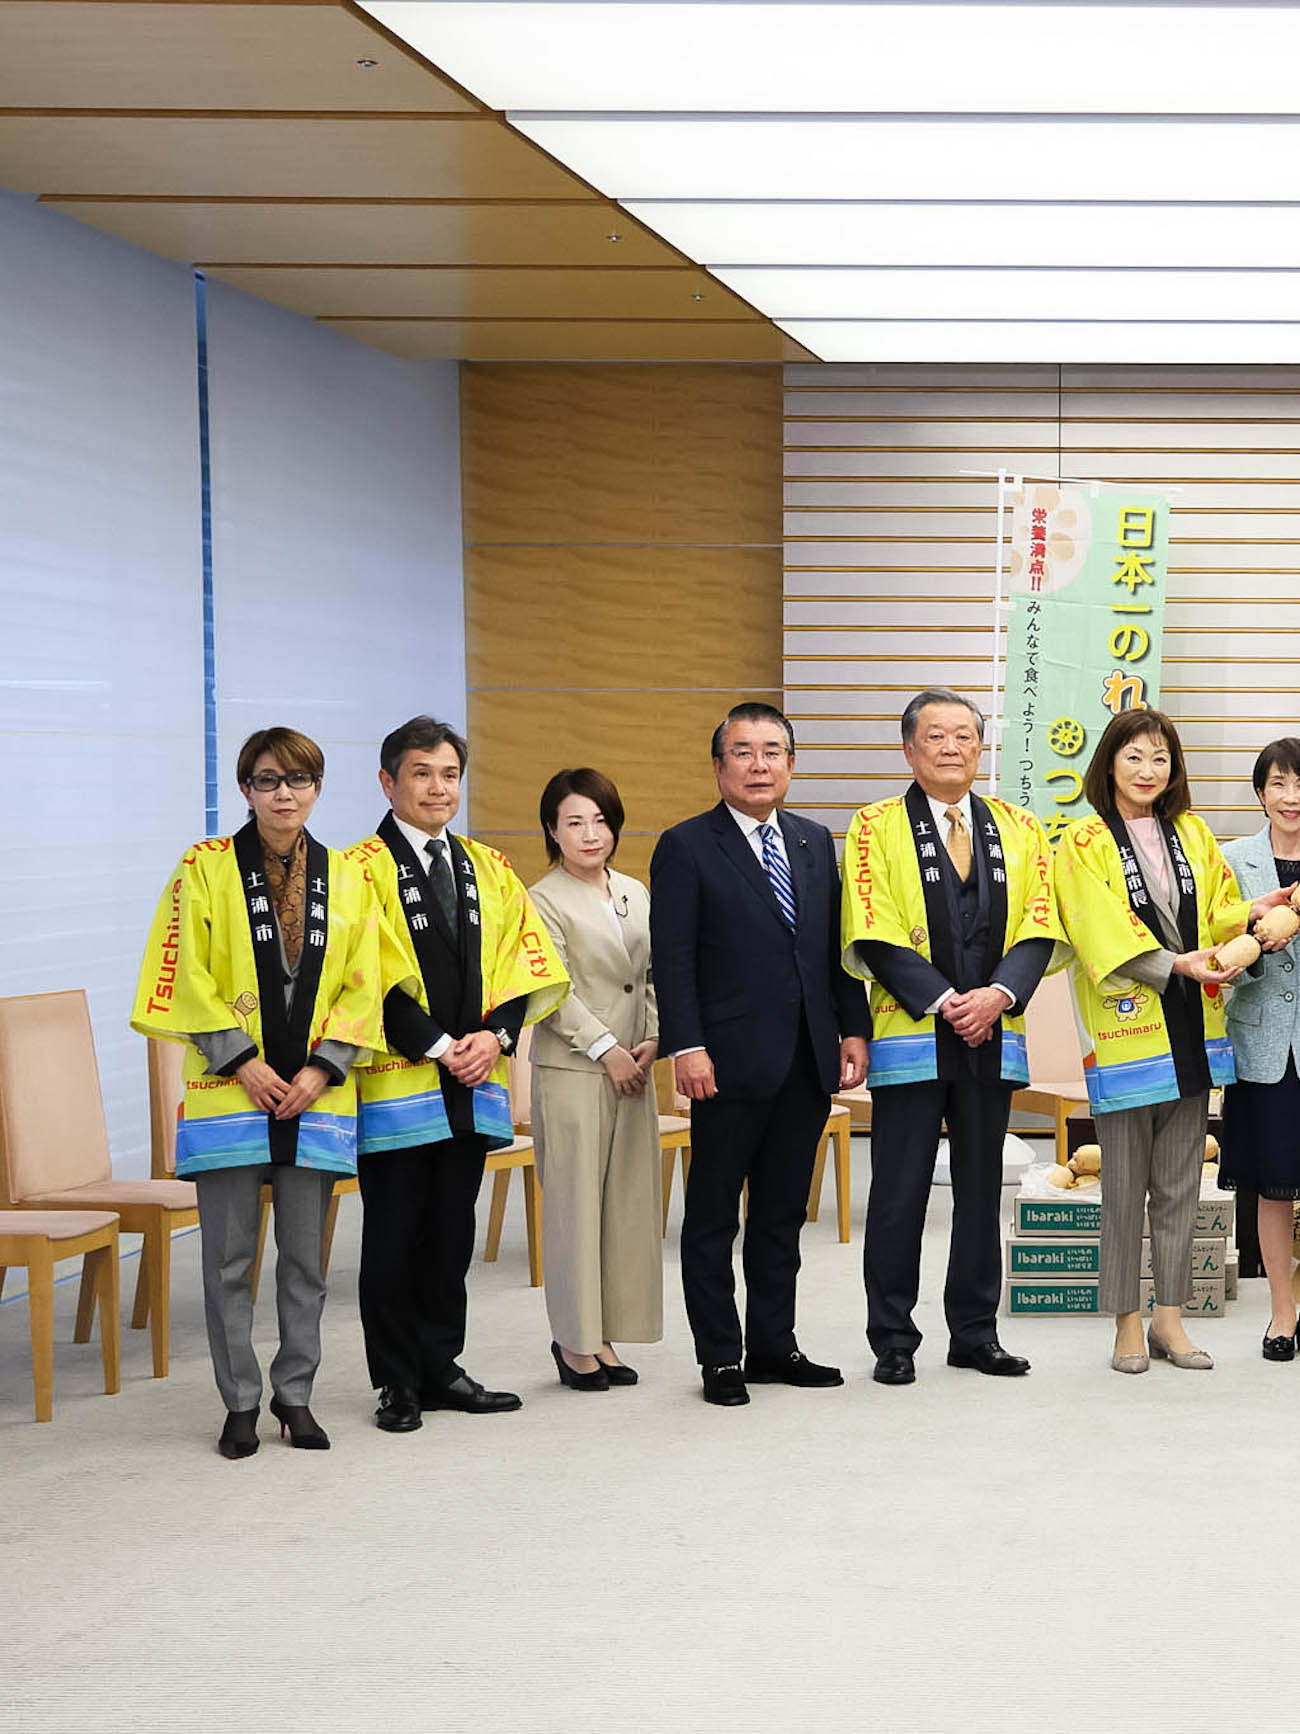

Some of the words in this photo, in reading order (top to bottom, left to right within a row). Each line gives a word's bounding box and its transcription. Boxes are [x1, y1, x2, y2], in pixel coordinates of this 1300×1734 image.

[916, 820, 941, 883] 土浦市
[985, 822, 1005, 883] 土浦市
[248, 872, 273, 942] 土浦市
[310, 877, 326, 947] 土浦市
[398, 864, 429, 931] 土浦市
[521, 931, 551, 978] City
[1098, 1022, 1162, 1040] tsuchimaru
[1026, 1210, 1073, 1222] Ibaraki
[1017, 1252, 1064, 1264] Ibaraki
[1017, 1292, 1064, 1304] Ibaraki
